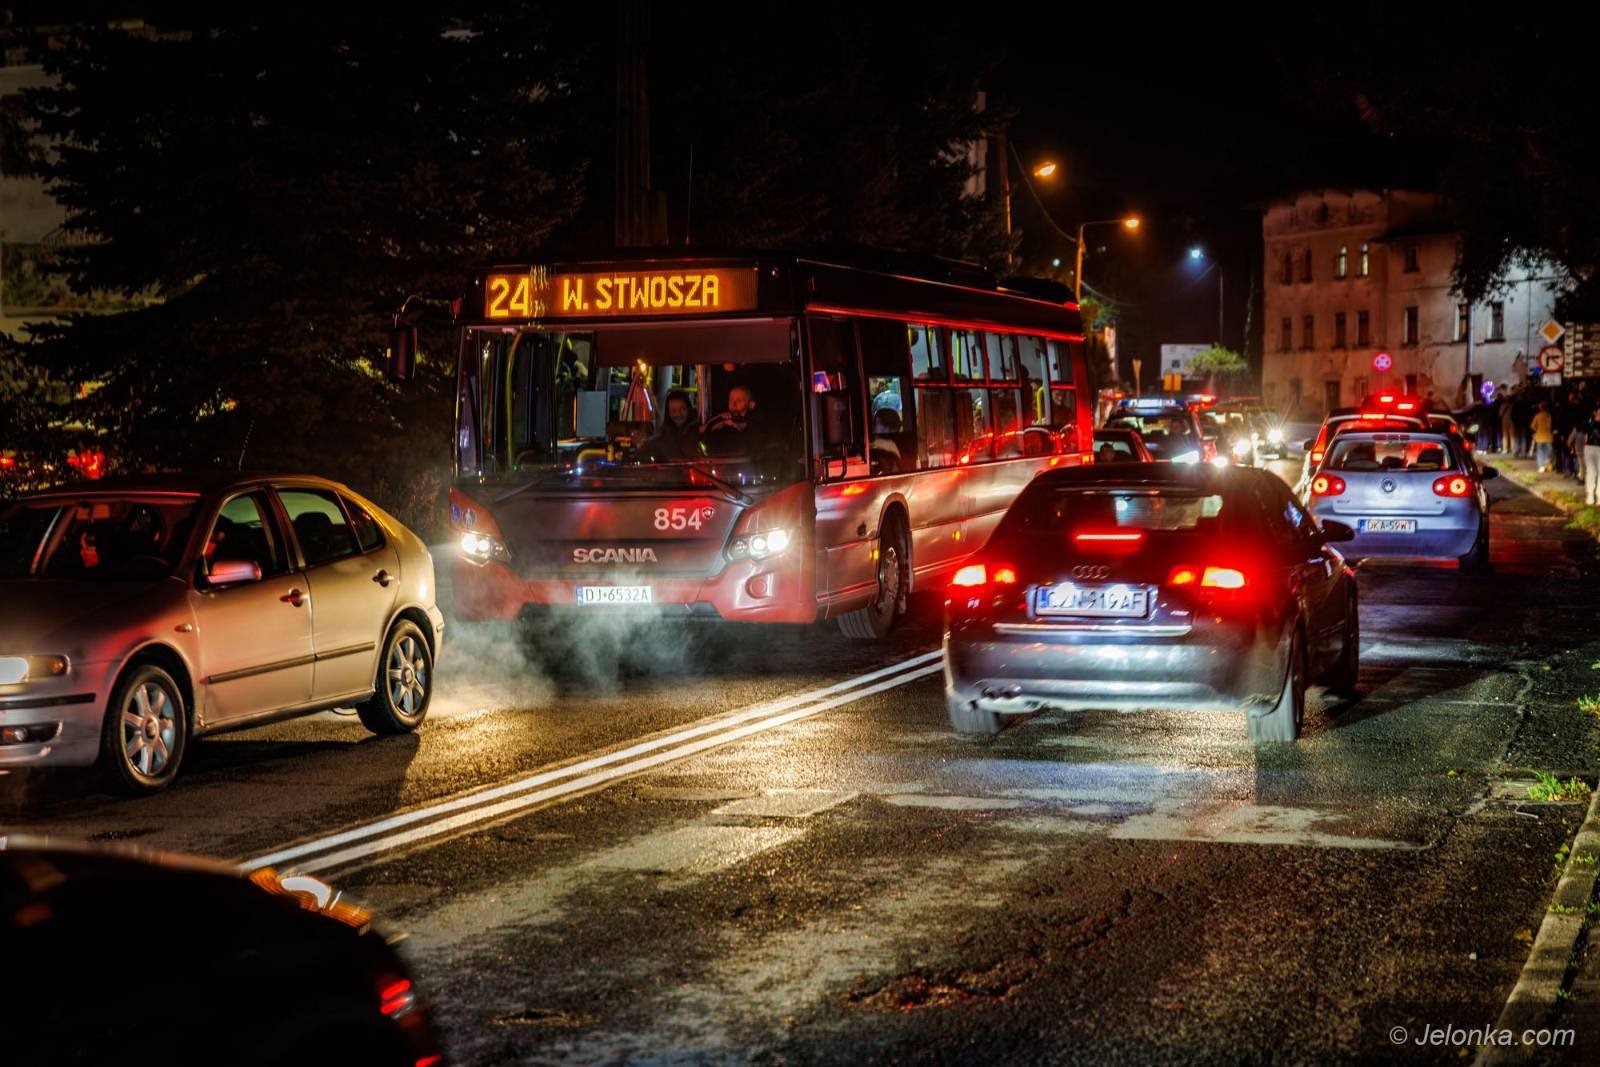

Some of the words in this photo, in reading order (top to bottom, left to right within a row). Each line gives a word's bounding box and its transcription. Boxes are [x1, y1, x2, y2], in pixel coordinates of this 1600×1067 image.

[490, 277, 529, 317] 24
[596, 274, 719, 310] STWOSZA
[654, 507, 702, 531] 854
[573, 547, 657, 564] SCANIA
